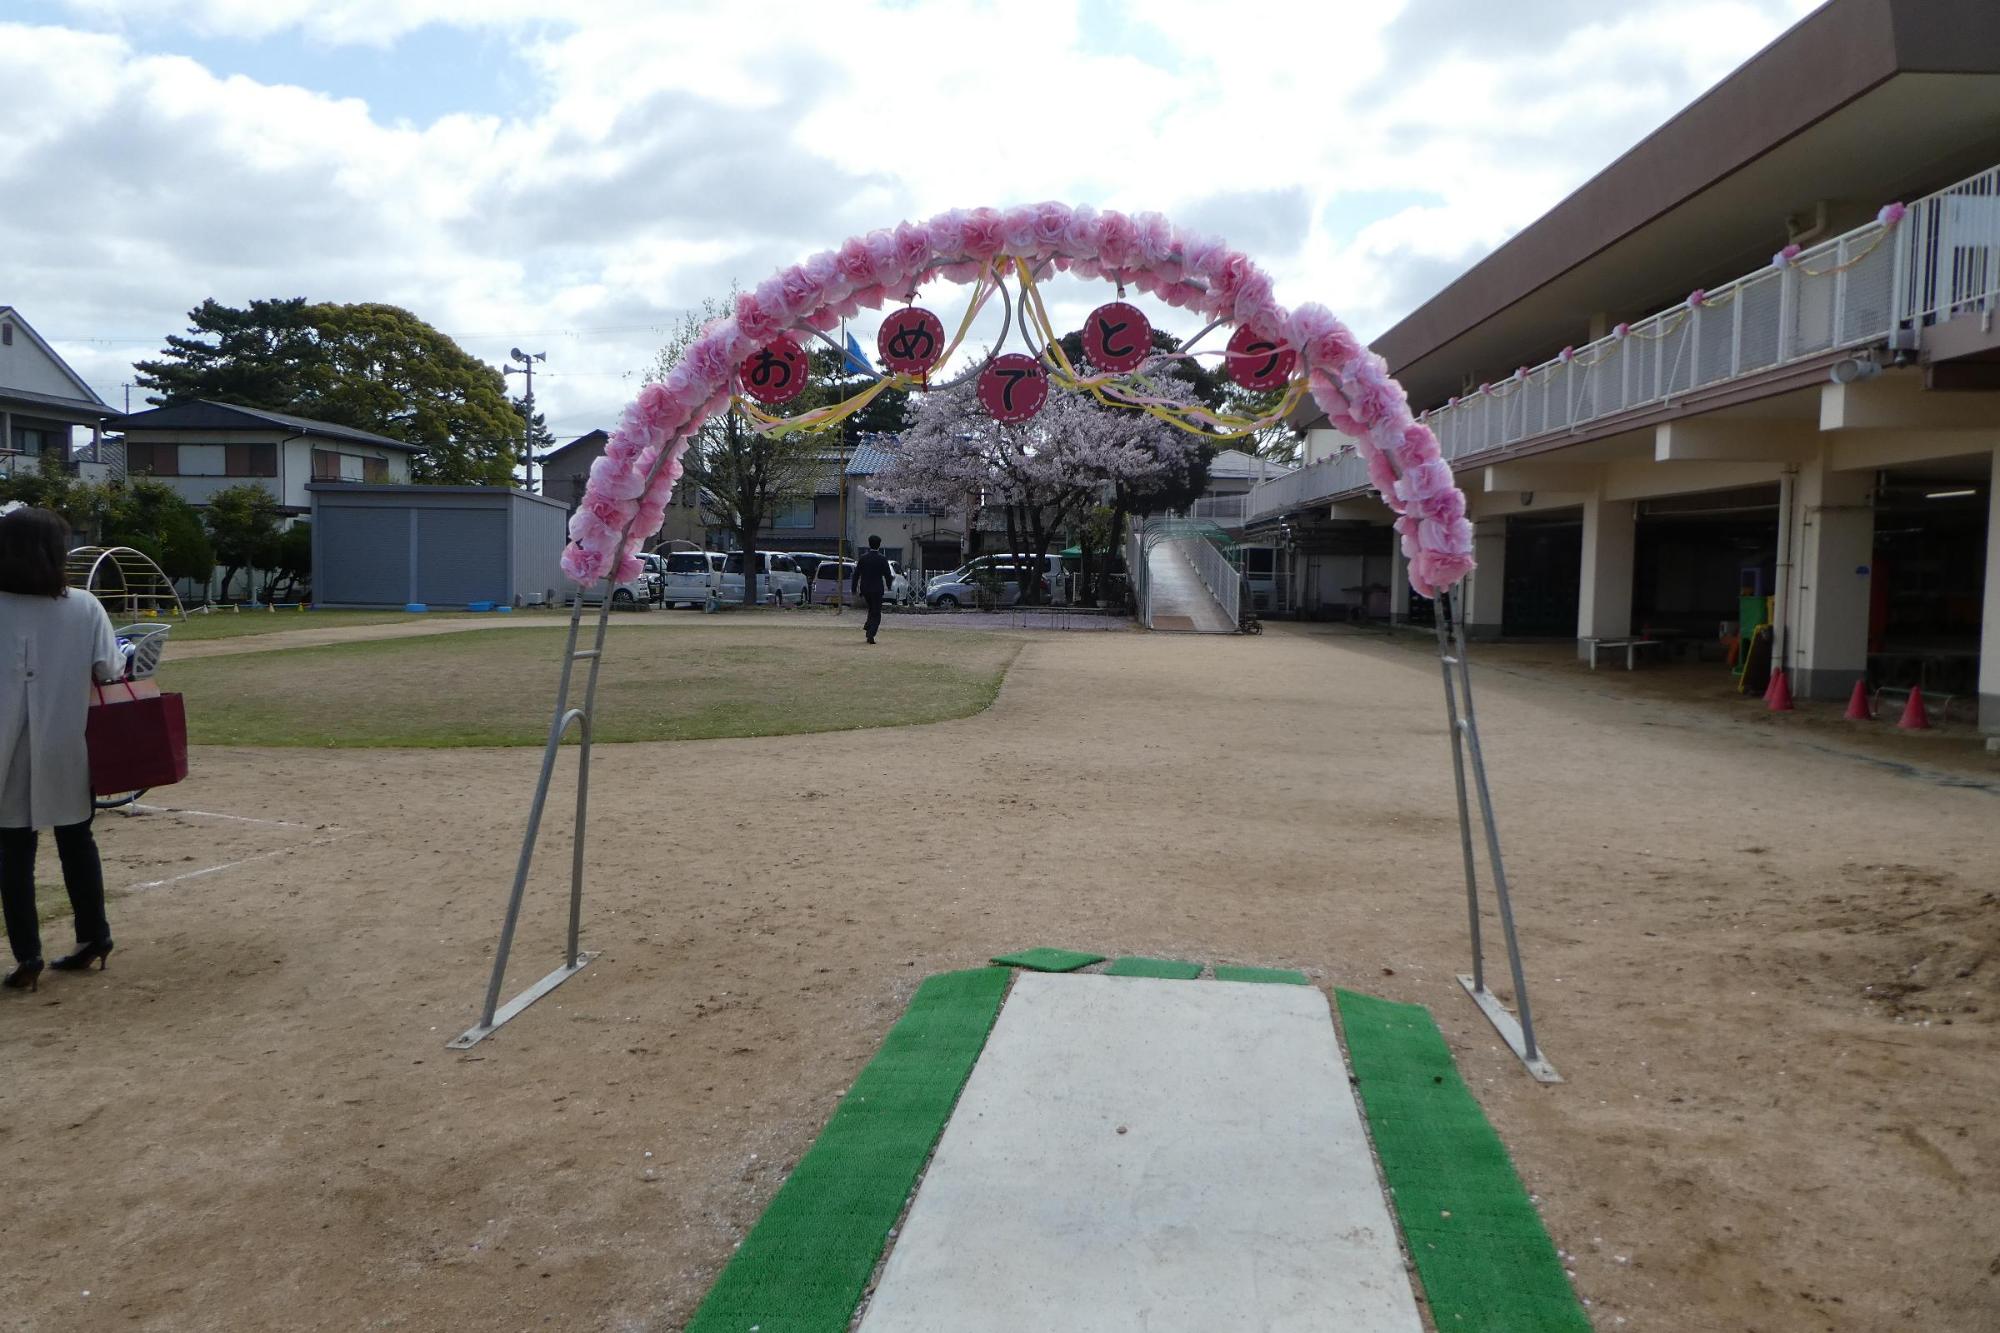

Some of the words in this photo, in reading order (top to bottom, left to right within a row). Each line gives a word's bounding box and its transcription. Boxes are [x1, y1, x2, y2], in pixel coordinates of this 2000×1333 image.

[751, 348, 795, 388] お
[887, 320, 934, 360] め
[995, 368, 1037, 411] で
[1099, 318, 1135, 357] と
